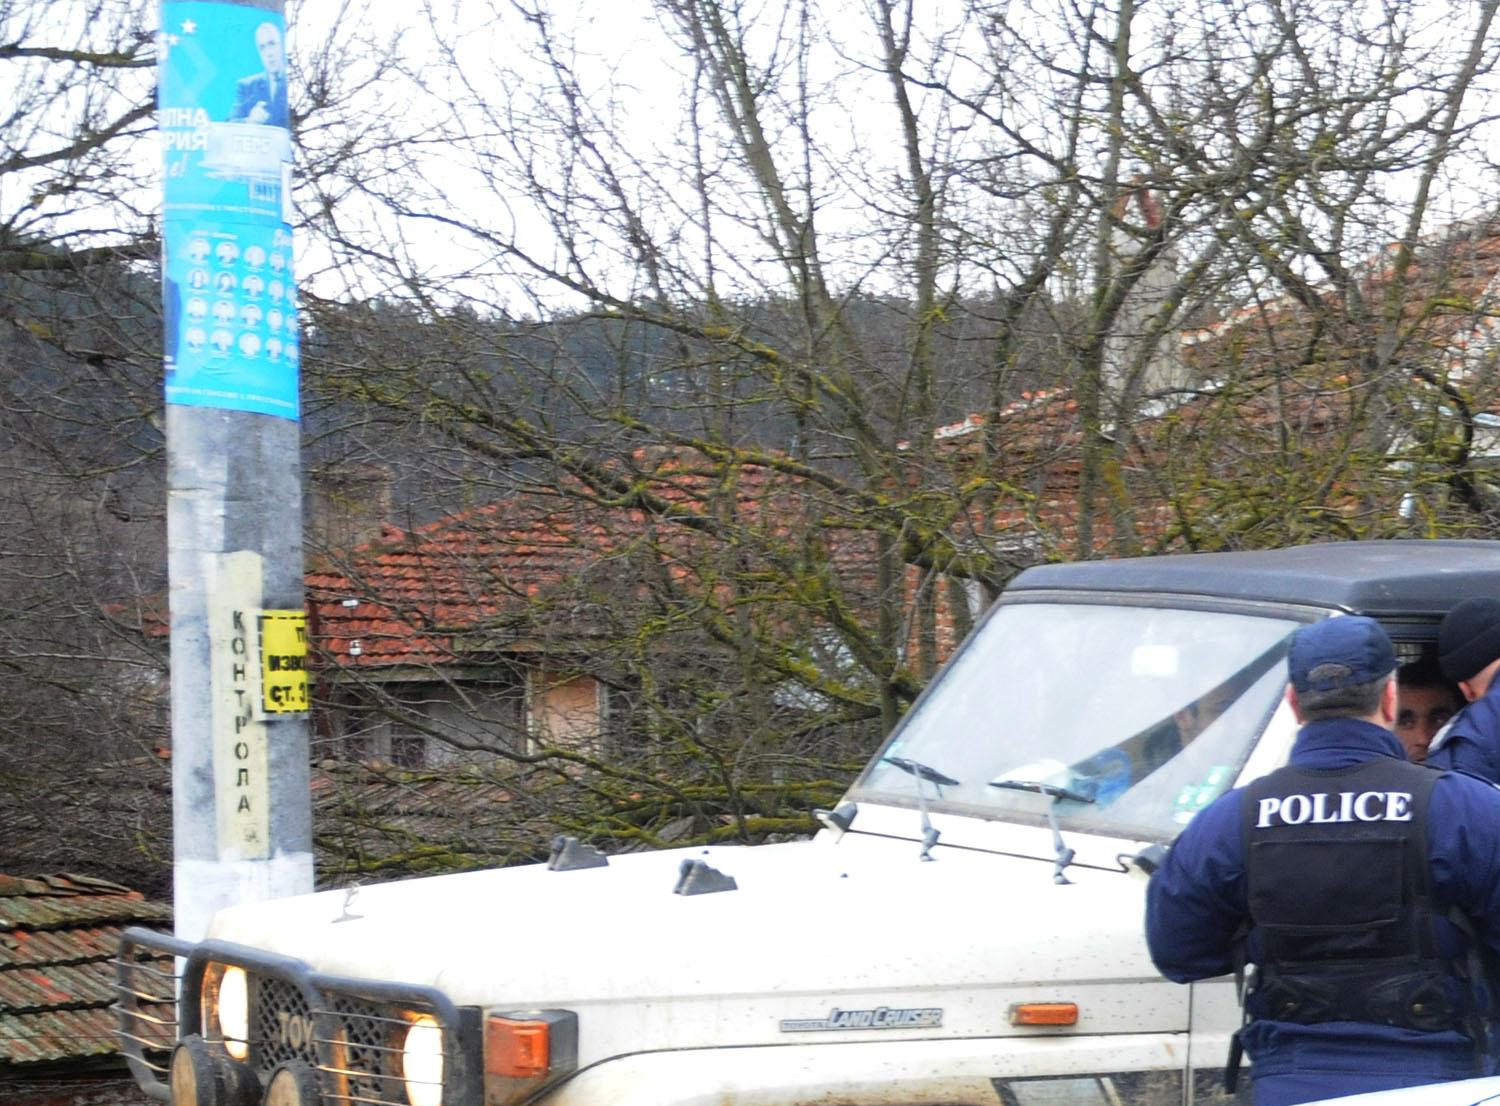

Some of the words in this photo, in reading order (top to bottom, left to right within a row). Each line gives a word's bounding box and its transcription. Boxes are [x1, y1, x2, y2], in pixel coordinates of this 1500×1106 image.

[161, 130, 209, 152] РИЯ
[232, 610, 251, 813] КОНТРОЛА
[1256, 791, 1413, 828] POLICE
[278, 1011, 316, 1051] TOY
